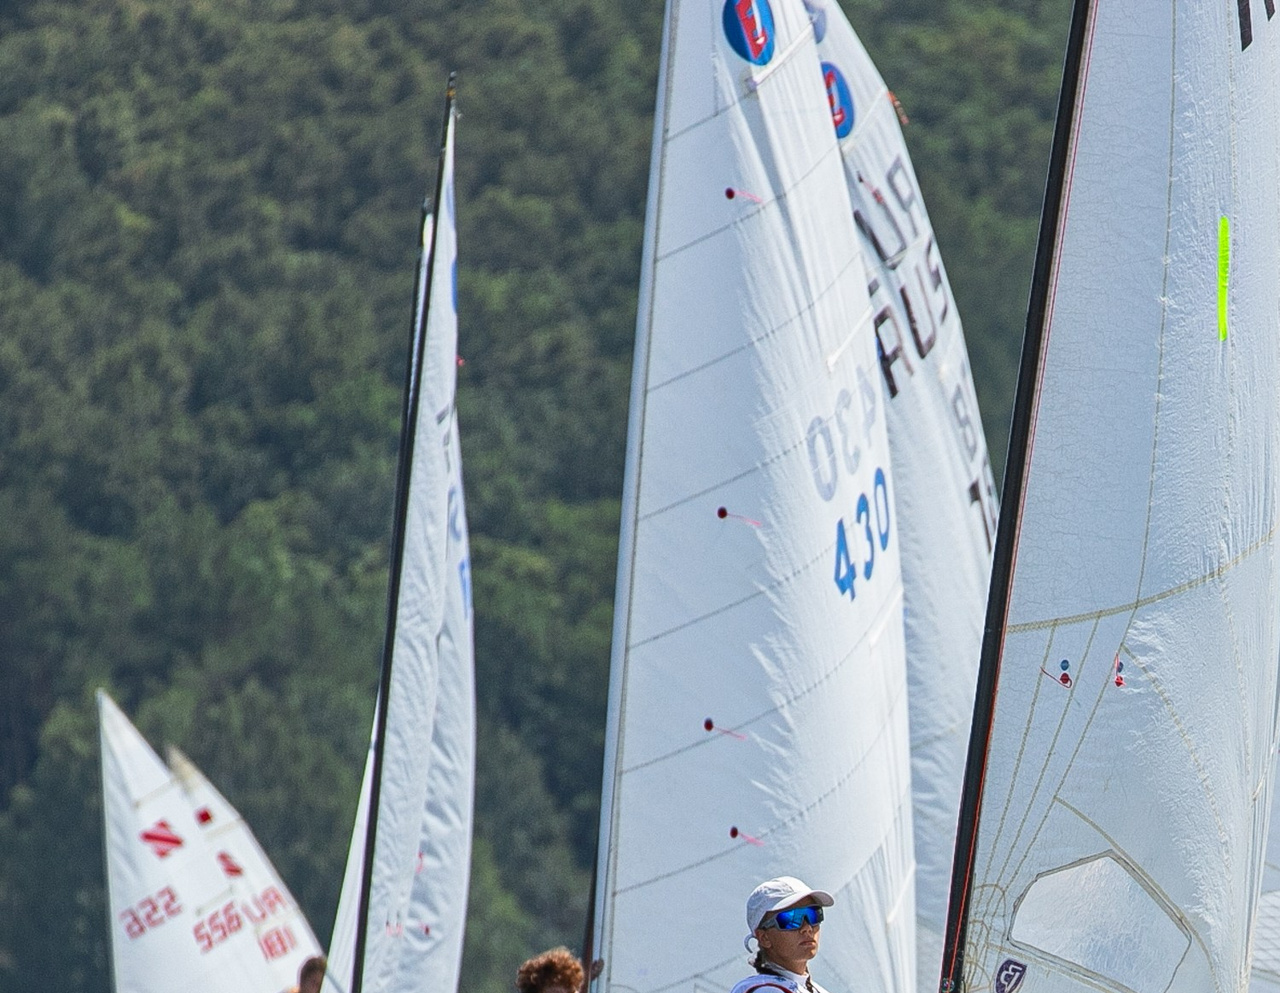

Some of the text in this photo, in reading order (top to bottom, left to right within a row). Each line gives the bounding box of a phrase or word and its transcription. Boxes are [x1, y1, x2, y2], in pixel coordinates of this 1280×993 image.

[874, 236, 948, 398] RUS
[834, 466, 890, 602] 430
[192, 900, 243, 954] 556
